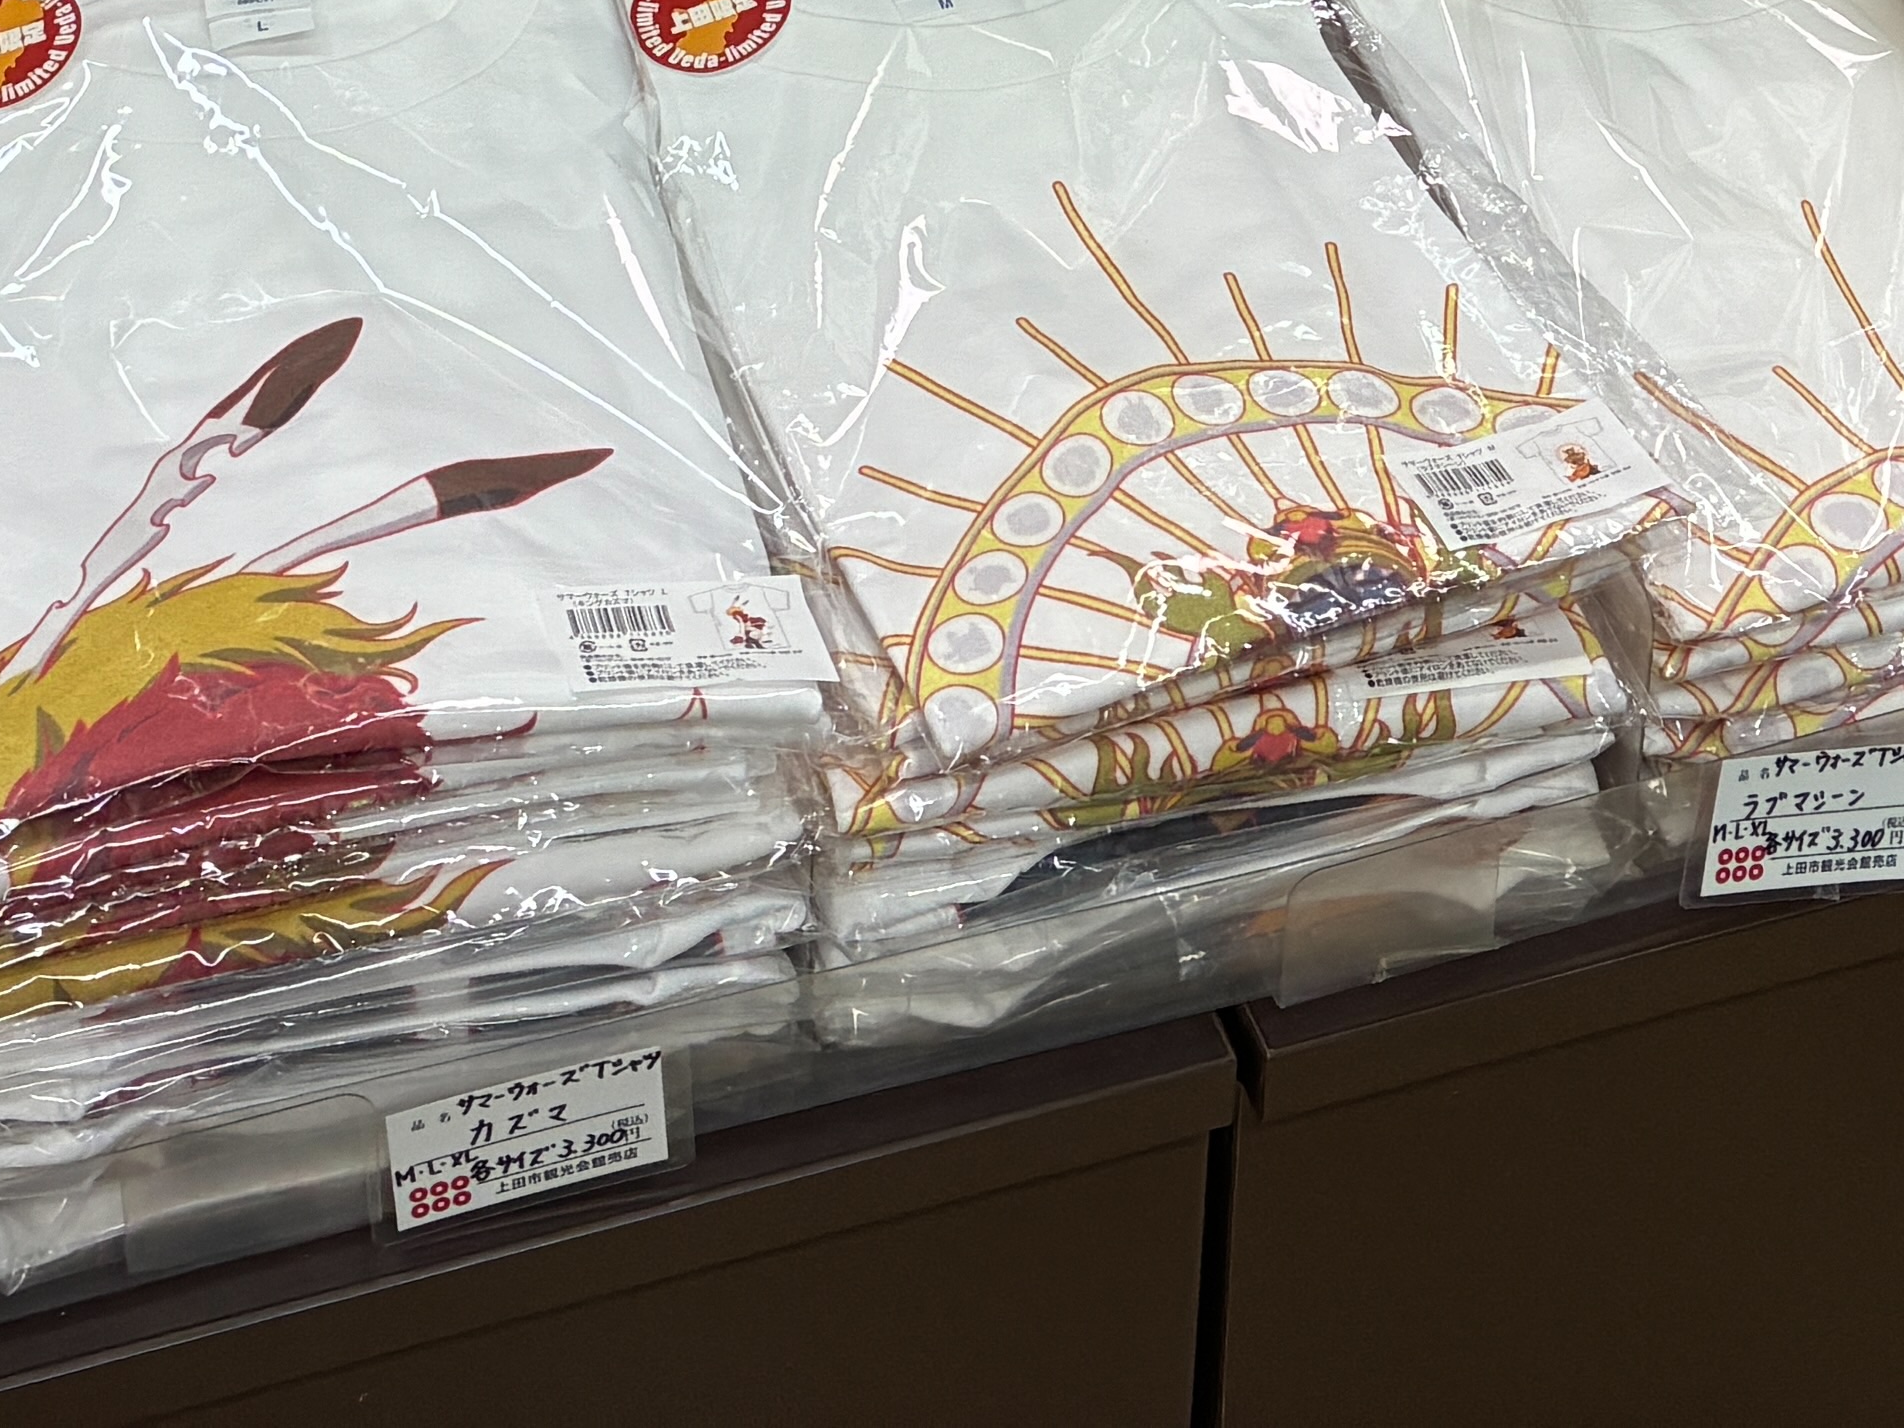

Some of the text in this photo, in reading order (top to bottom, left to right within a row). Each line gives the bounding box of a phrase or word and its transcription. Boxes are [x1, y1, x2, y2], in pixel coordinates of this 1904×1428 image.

[256, 20, 269, 32] L
[1890, 831, 1904, 844] 円
[1782, 855, 1897, 876] 上田市観光会館売店
[457, 1050, 661, 1114] サマーウォーズTシャツ
[471, 1104, 567, 1145] カズマ
[496, 1147, 638, 1194] 上田市観光会館売店
